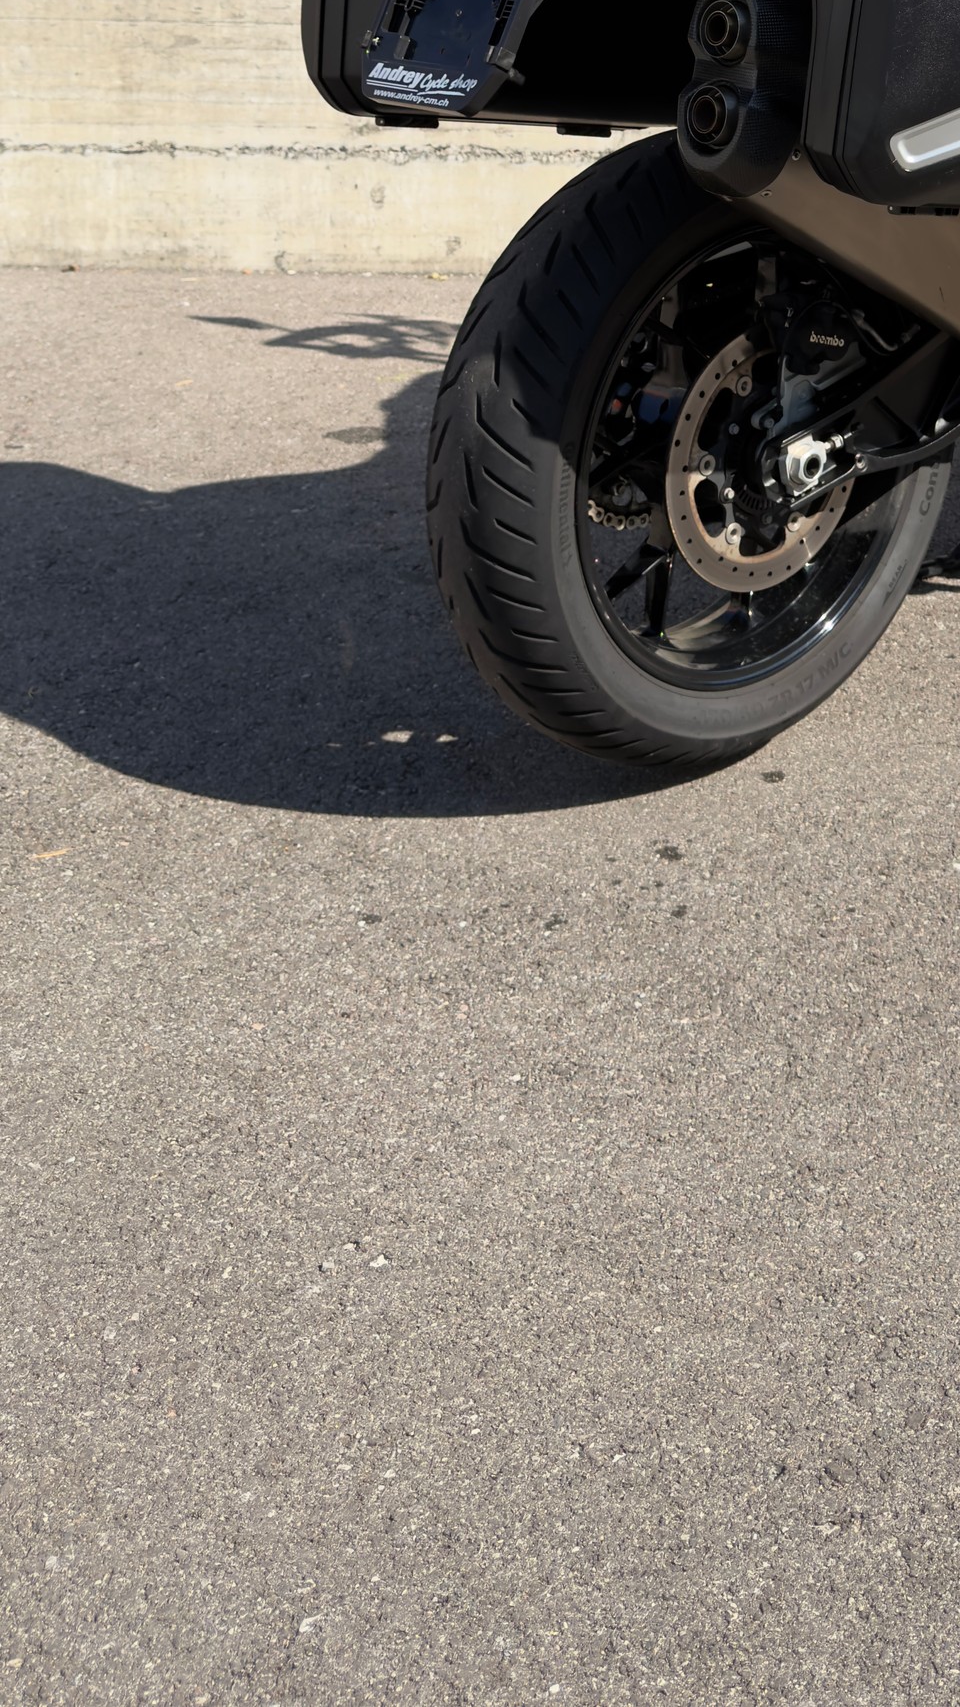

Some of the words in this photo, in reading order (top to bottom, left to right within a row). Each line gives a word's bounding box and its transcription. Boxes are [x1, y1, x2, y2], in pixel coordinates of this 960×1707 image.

[368, 62, 425, 89] Andrey
[420, 74, 450, 92] Cycle
[449, 74, 478, 92] shop
[373, 89, 450, 107] www.andrey-cm.ch
[810, 330, 845, 347] brembo
